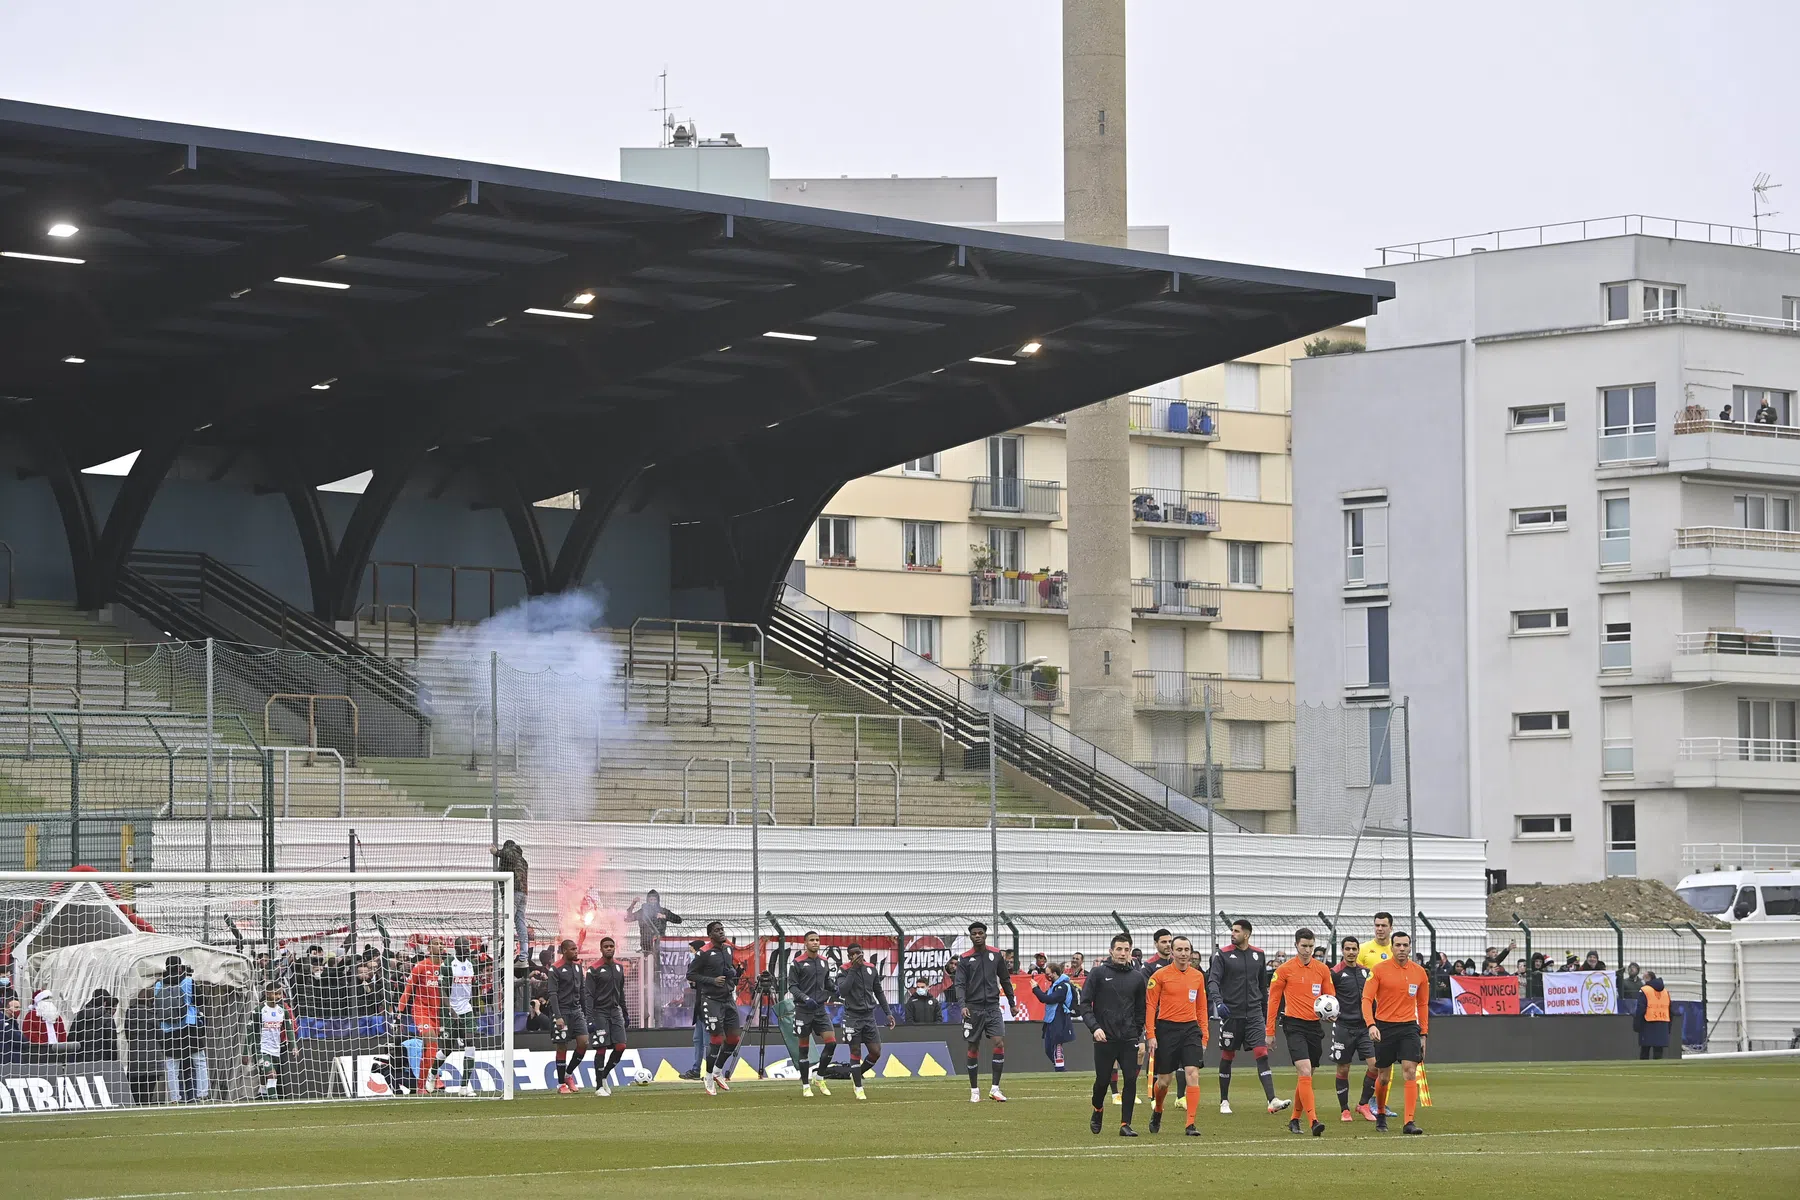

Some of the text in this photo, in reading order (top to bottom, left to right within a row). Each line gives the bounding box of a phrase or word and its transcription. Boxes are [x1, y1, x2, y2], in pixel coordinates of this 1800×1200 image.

[904, 949, 951, 969] ZUVENA
[1480, 984, 1517, 997] MUNEGU
[1568, 986, 1578, 994] KM
[1495, 1000, 1506, 1011] 51
[1547, 998, 1580, 1008] POUR NOS
